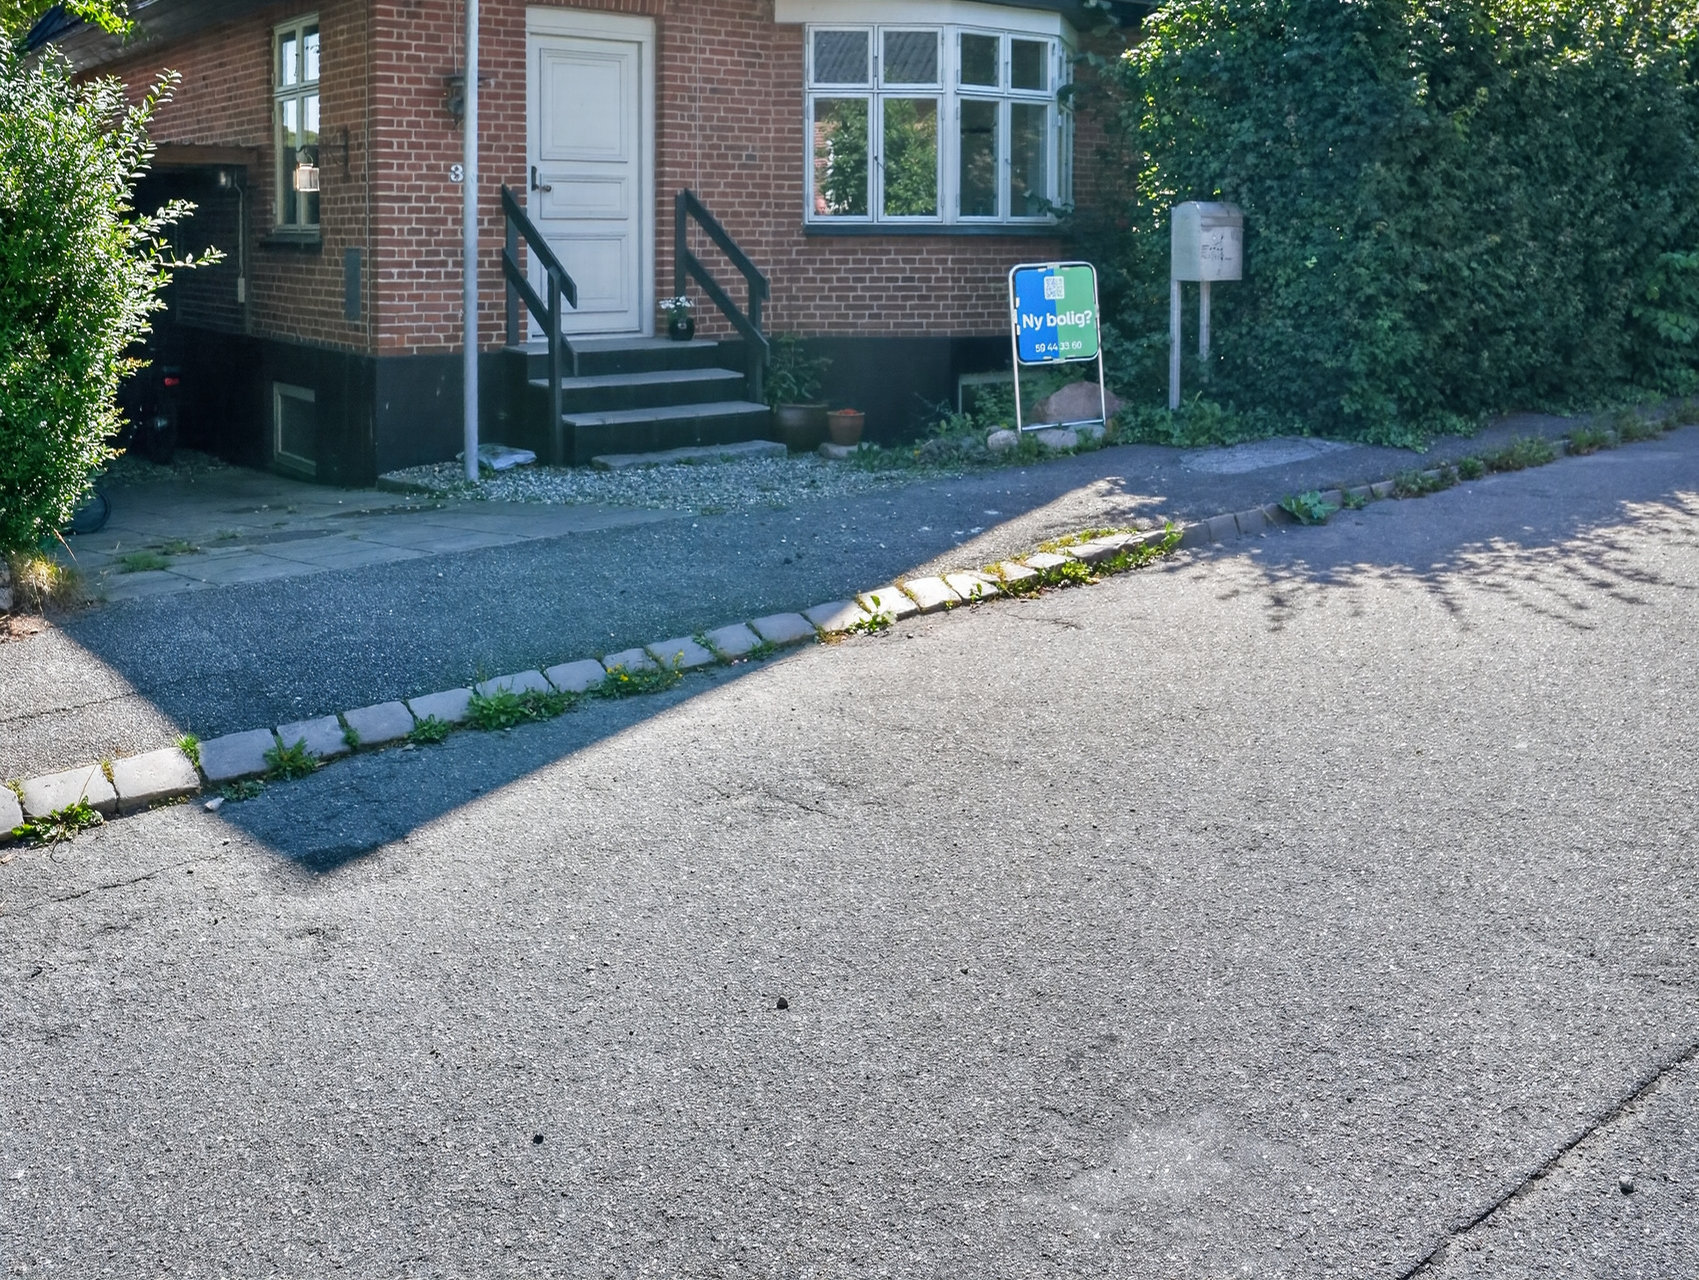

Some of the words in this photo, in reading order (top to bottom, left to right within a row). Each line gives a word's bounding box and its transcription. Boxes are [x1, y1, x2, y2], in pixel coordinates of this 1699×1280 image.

[450, 164, 464, 182] 3
[1022, 313, 1043, 331] Ny
[1046, 310, 1092, 328] bolig?
[1047, 342, 1058, 351] 44
[1071, 340, 1082, 350] 60
